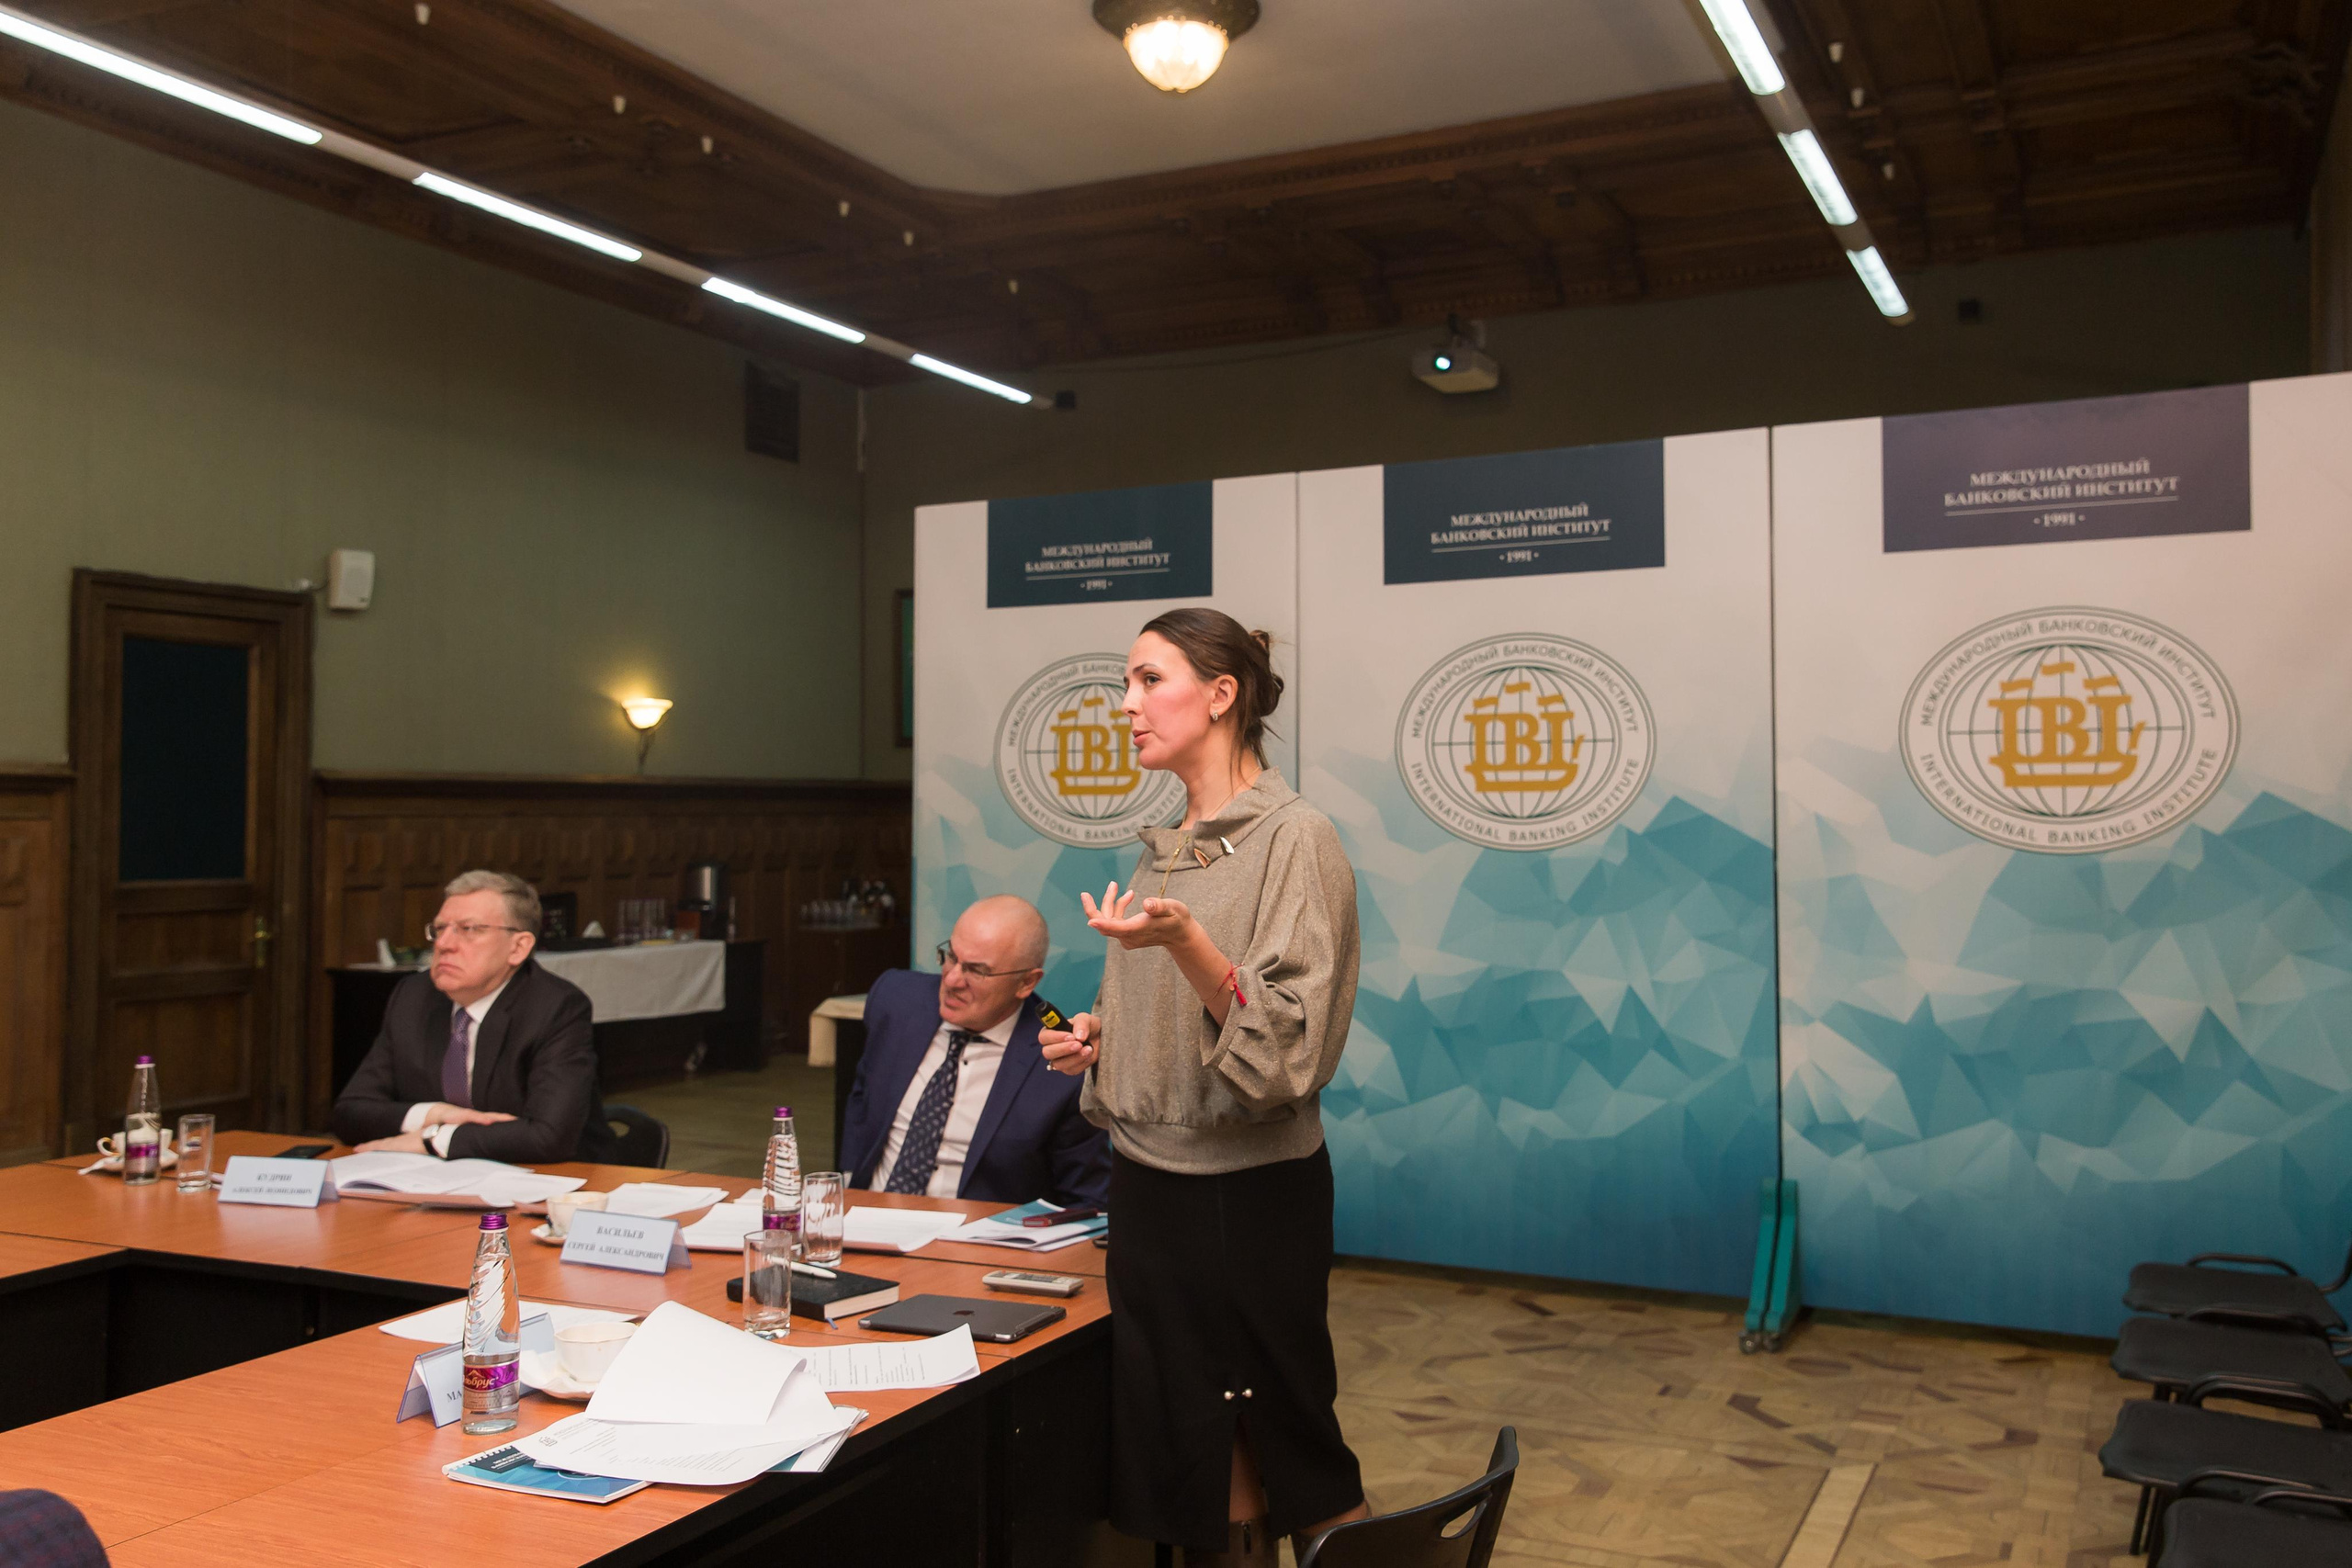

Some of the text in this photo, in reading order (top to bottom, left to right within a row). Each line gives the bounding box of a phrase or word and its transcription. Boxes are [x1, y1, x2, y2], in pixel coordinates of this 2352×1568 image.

[1970, 457, 2151, 487] МЕЖДУНАРОДНЫЙ
[1944, 476, 2180, 507] БАНКОВСКИЙ ИНСТИТУТ
[1451, 502, 1589, 527] МЕЖДУНАРОДНЫЙ
[2043, 512, 2076, 527] 1991
[1430, 519, 1611, 545] БАНКОВСКИЙ ИНСТИТУТ
[1041, 536, 1153, 558] МЕЖДУНАРОДНЫЙ
[1507, 550, 1532, 563] 1991
[1024, 553, 1170, 573] БАНКОВСКИЙ ИНСТИТУТ
[1082, 663, 1126, 675] БАНКОВ
[1920, 619, 2216, 727] МЕЖДУНАРОДНЫЙ БАНКОВСКИЙ ИНСТИТУТ
[1411, 645, 1639, 739] МЕЖДУНАРОДНЫЙ БАНКОВСКИЙ ИНСТИТУТ
[1007, 768, 1184, 840] INTERNATIONAL BANKING INSTITU
[1410, 758, 1640, 842] INTERNATIONAL BANKING INSTITUTE
[1919, 749, 2217, 844] INTERNATIONAL BANKING INSTITUTE
[597, 1225, 646, 1239] ВАСИЛЬЕВ
[567, 1240, 665, 1260] СЕРГЕЙ АЛЕКСАНДРОВИЧ
[447, 1390, 462, 1404] МА
